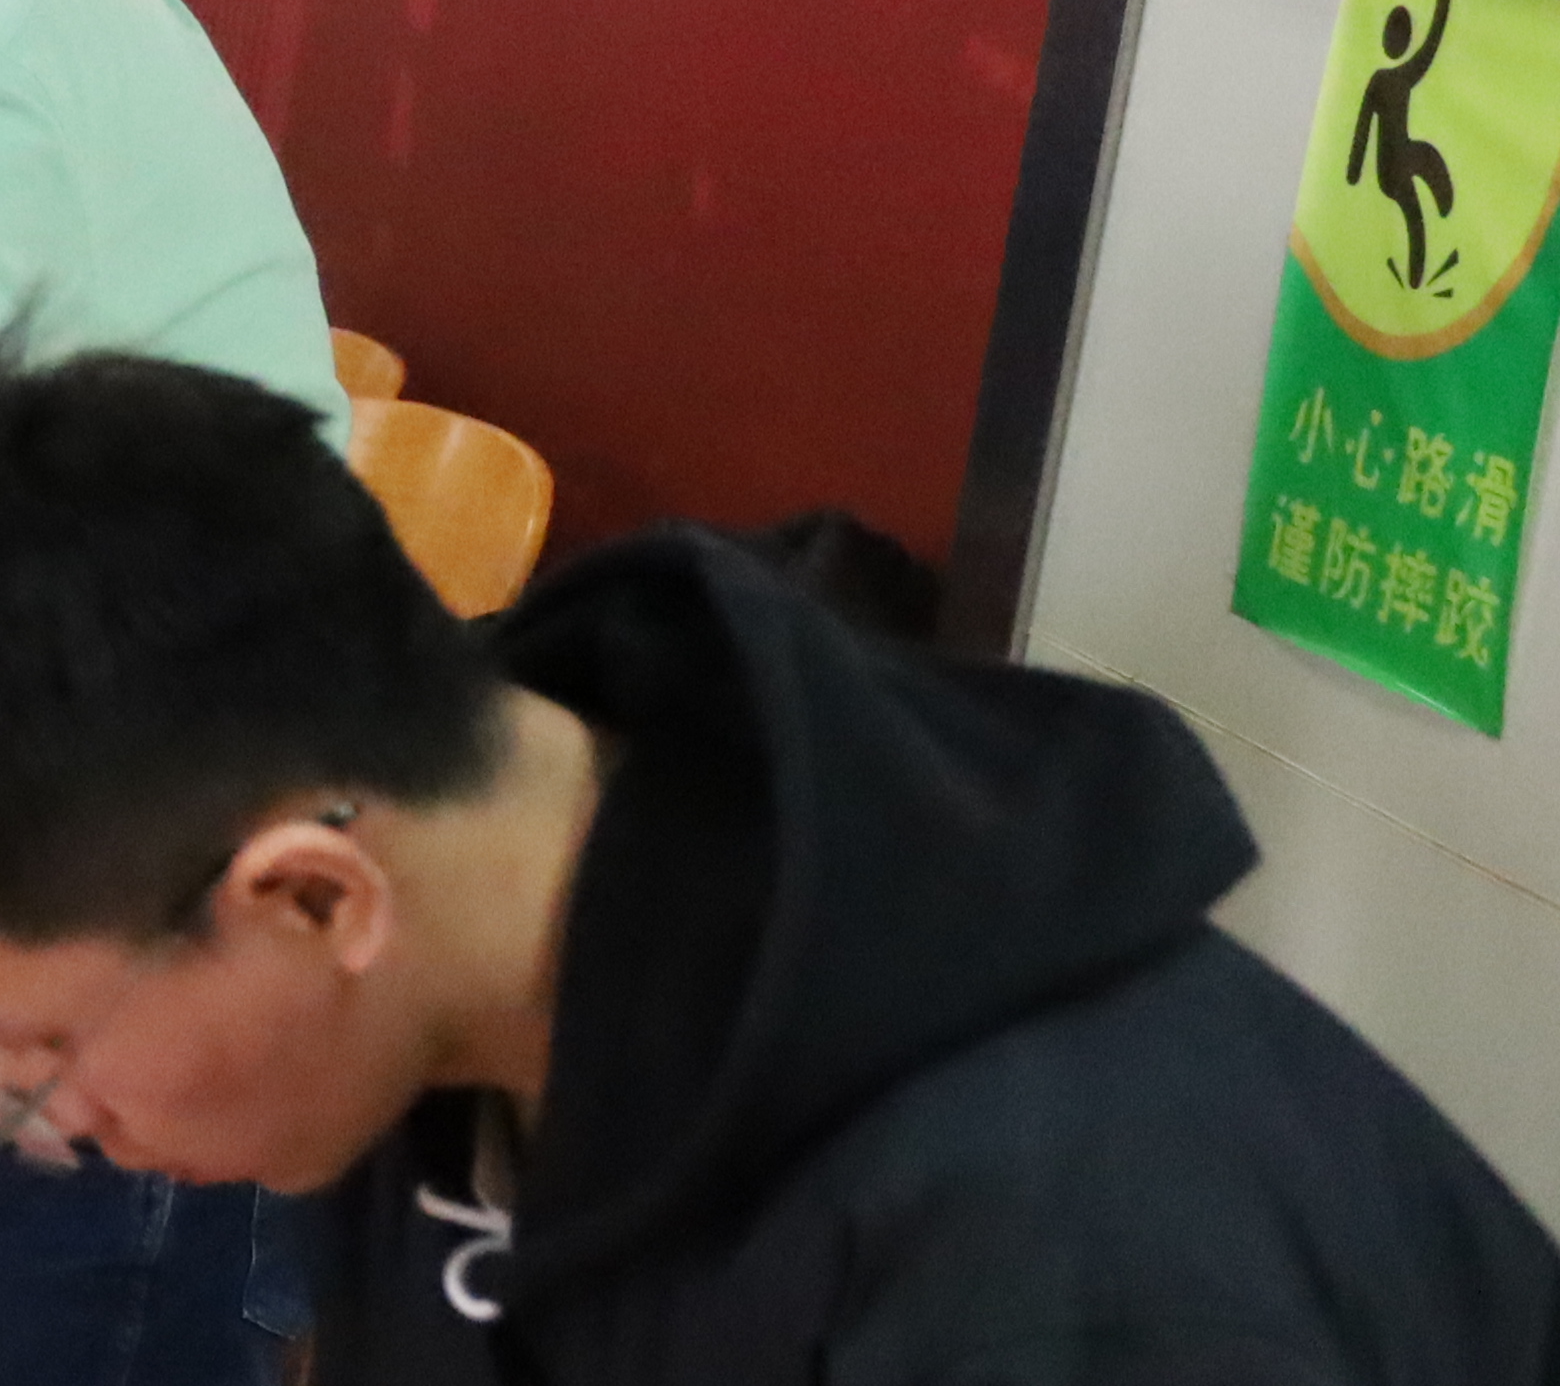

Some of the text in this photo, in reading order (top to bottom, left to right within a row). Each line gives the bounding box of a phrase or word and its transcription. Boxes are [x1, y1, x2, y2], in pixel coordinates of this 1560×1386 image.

[1292, 385, 1518, 549] 小心路滑
[1266, 495, 1502, 670] 谨防摔跤
